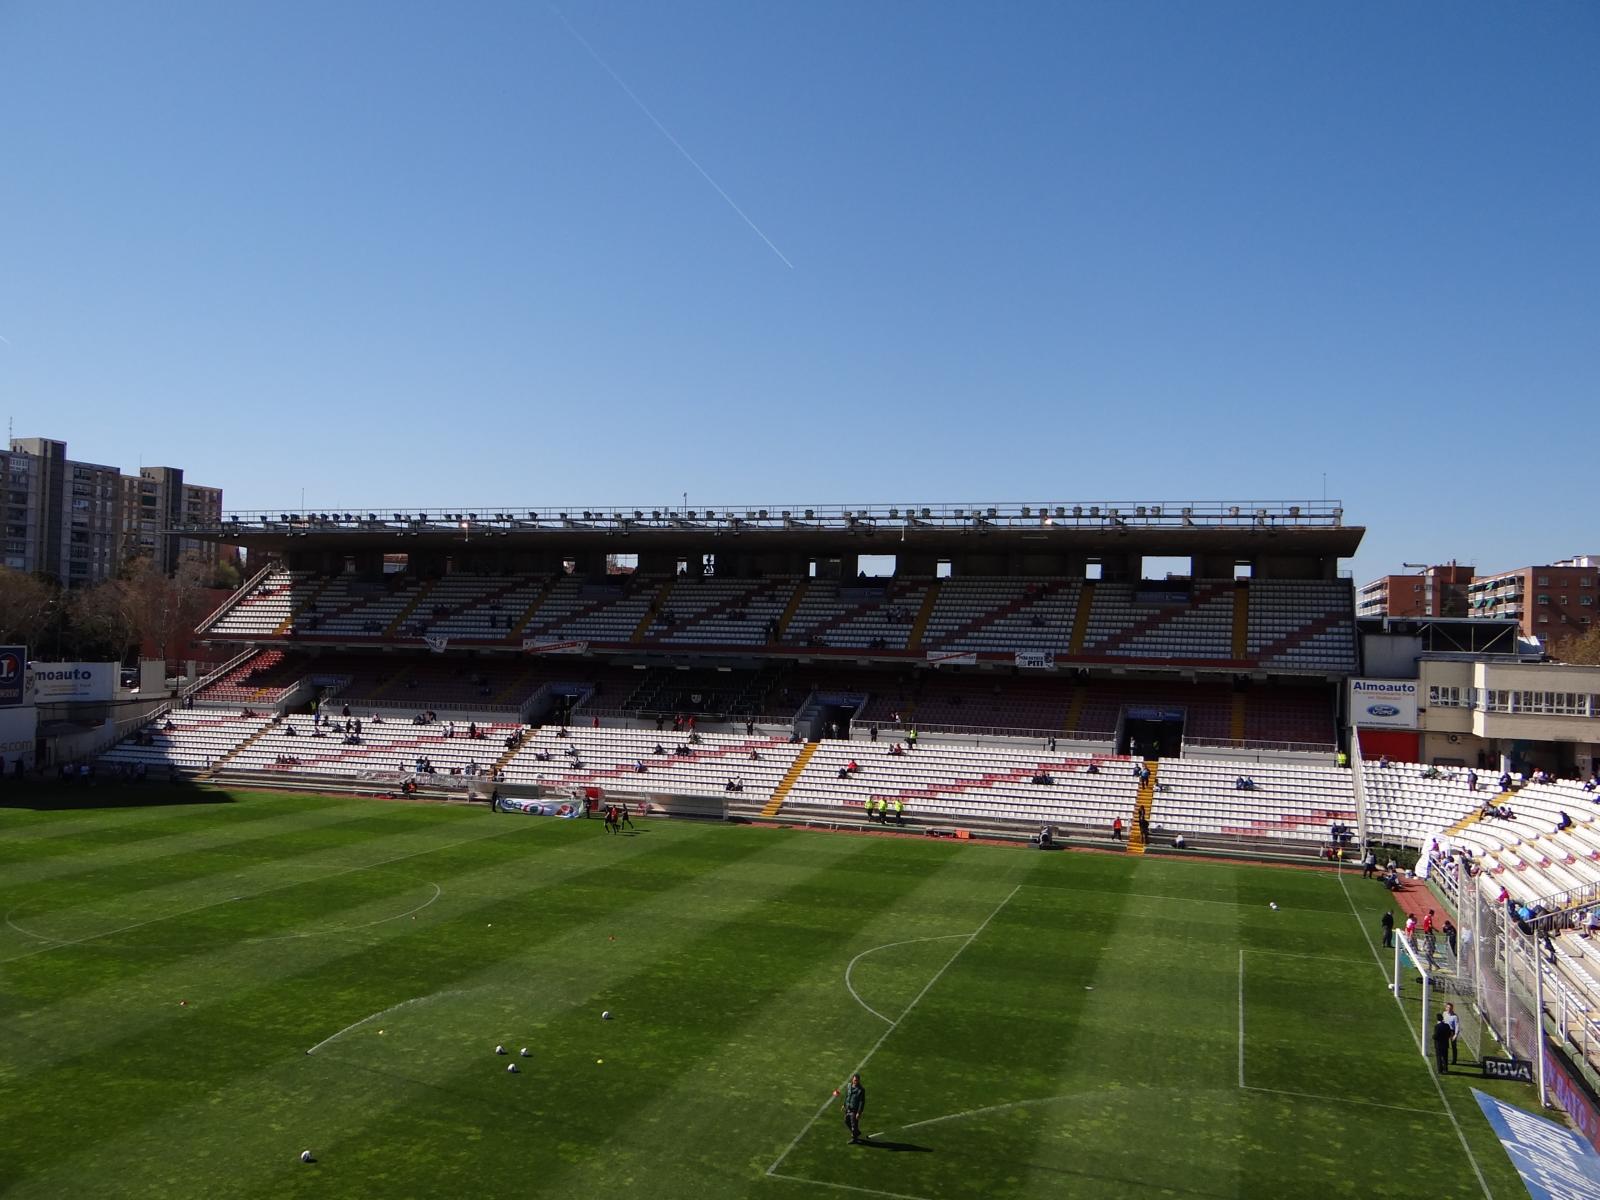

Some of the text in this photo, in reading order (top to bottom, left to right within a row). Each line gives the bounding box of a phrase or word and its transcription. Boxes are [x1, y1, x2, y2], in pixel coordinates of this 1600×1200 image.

[35, 669, 92, 680] moauto
[1353, 682, 1415, 692] Almoauto
[1486, 1060, 1531, 1080] BBVA
